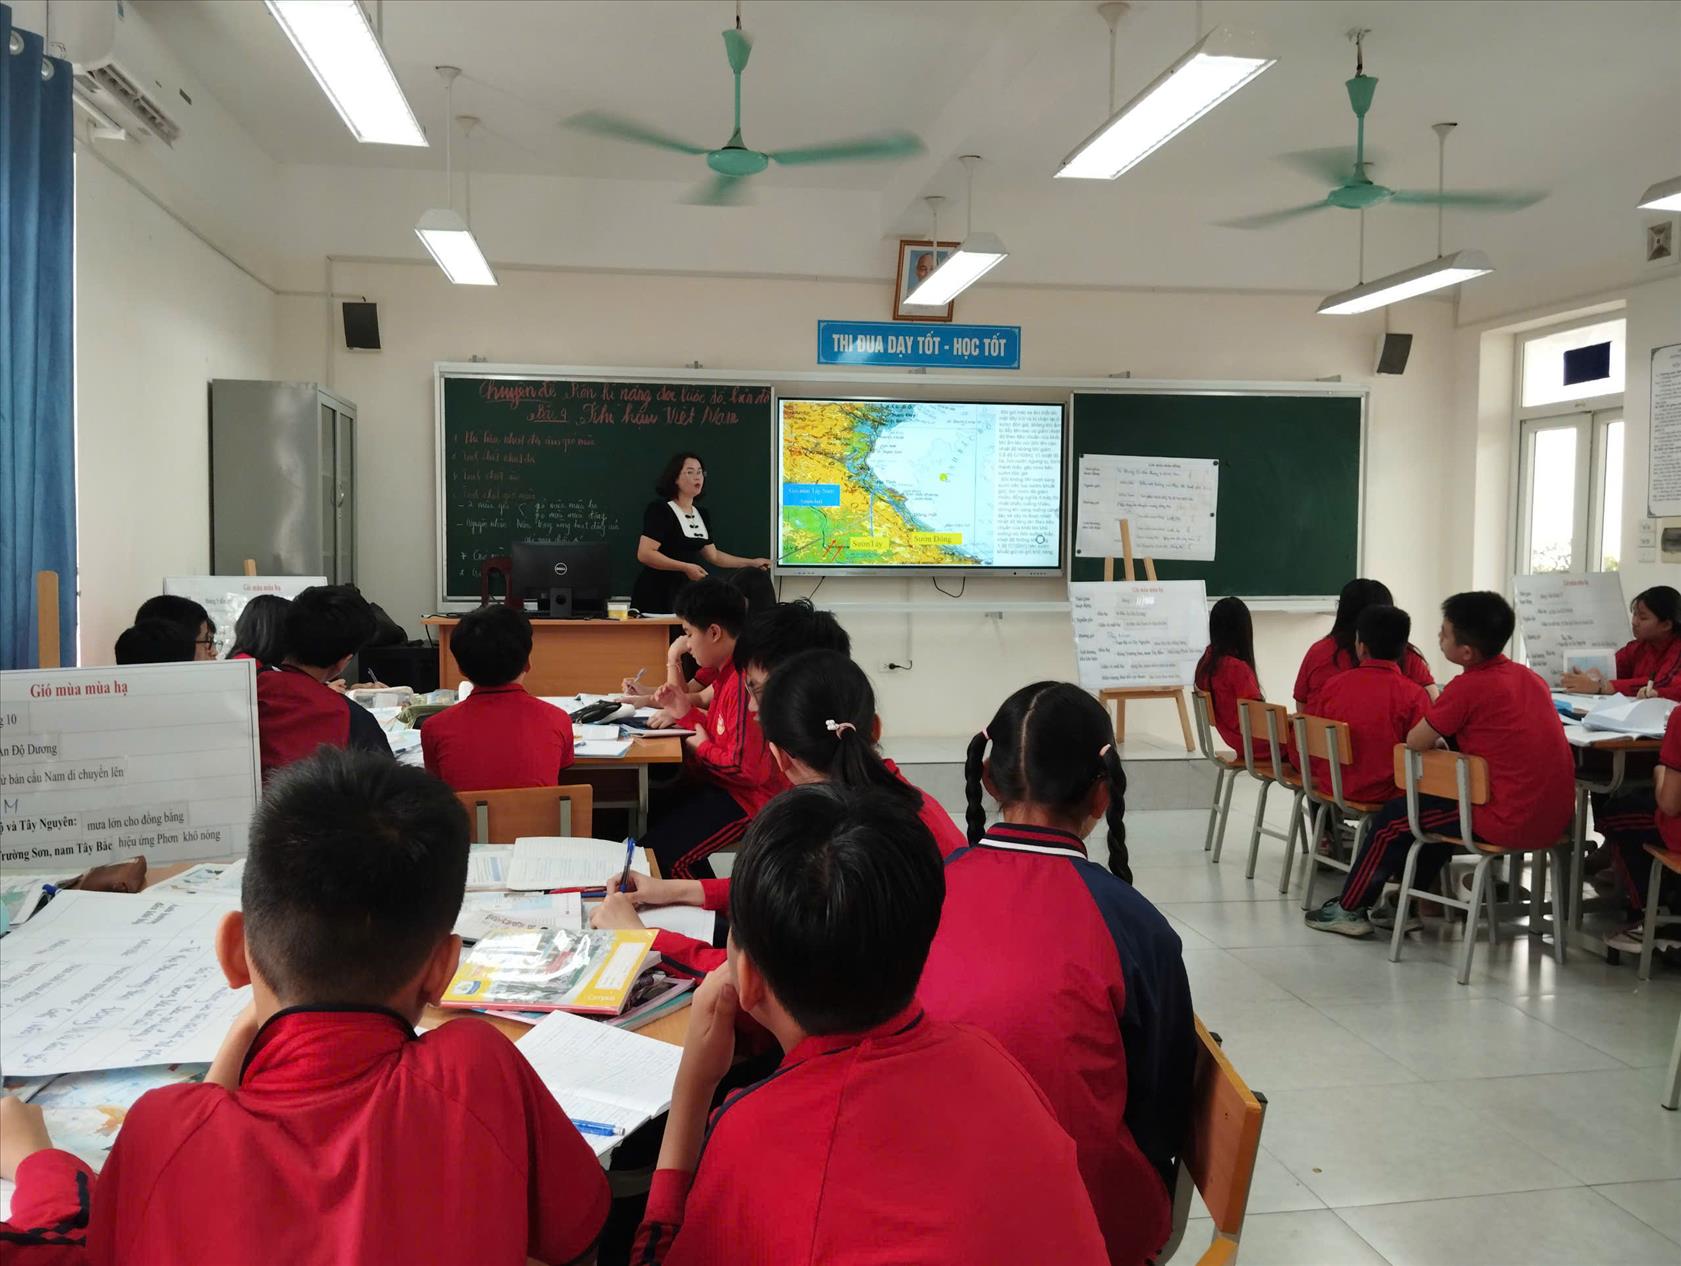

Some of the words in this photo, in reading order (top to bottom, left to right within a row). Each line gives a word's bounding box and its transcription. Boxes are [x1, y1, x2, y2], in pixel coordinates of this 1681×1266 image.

[832, 334, 853, 352] THI
[856, 334, 884, 353] ĐUA
[888, 336, 914, 358] DẠY
[918, 330, 940, 355] TỐT
[953, 338, 980, 360] HỌC
[984, 332, 1006, 357] TỐT
[30, 683, 52, 698] Gió
[56, 682, 81, 696] mùa
[86, 680, 110, 695] mùa
[114, 680, 128, 696] hạ
[6, 714, 17, 725] 10
[12, 744, 25, 757] Độ
[28, 744, 58, 756] Dương
[44, 772, 65, 782] Nam
[78, 764, 108, 782] chuyển
[112, 766, 124, 778] lên
[6, 821, 17, 832] và
[20, 818, 36, 832] Tây
[40, 816, 77, 831] Nguyên:
[87, 820, 106, 830] mưa
[124, 816, 139, 827] cho
[141, 810, 162, 826] đồng
[118, 835, 137, 848] hiệu
[157, 833, 179, 844] Phơn
[182, 831, 198, 842] khô
[32, 847, 52, 858] Sơn,
[54, 846, 74, 856] nam
[77, 842, 93, 855] Tây
[96, 841, 113, 852] Bắc
